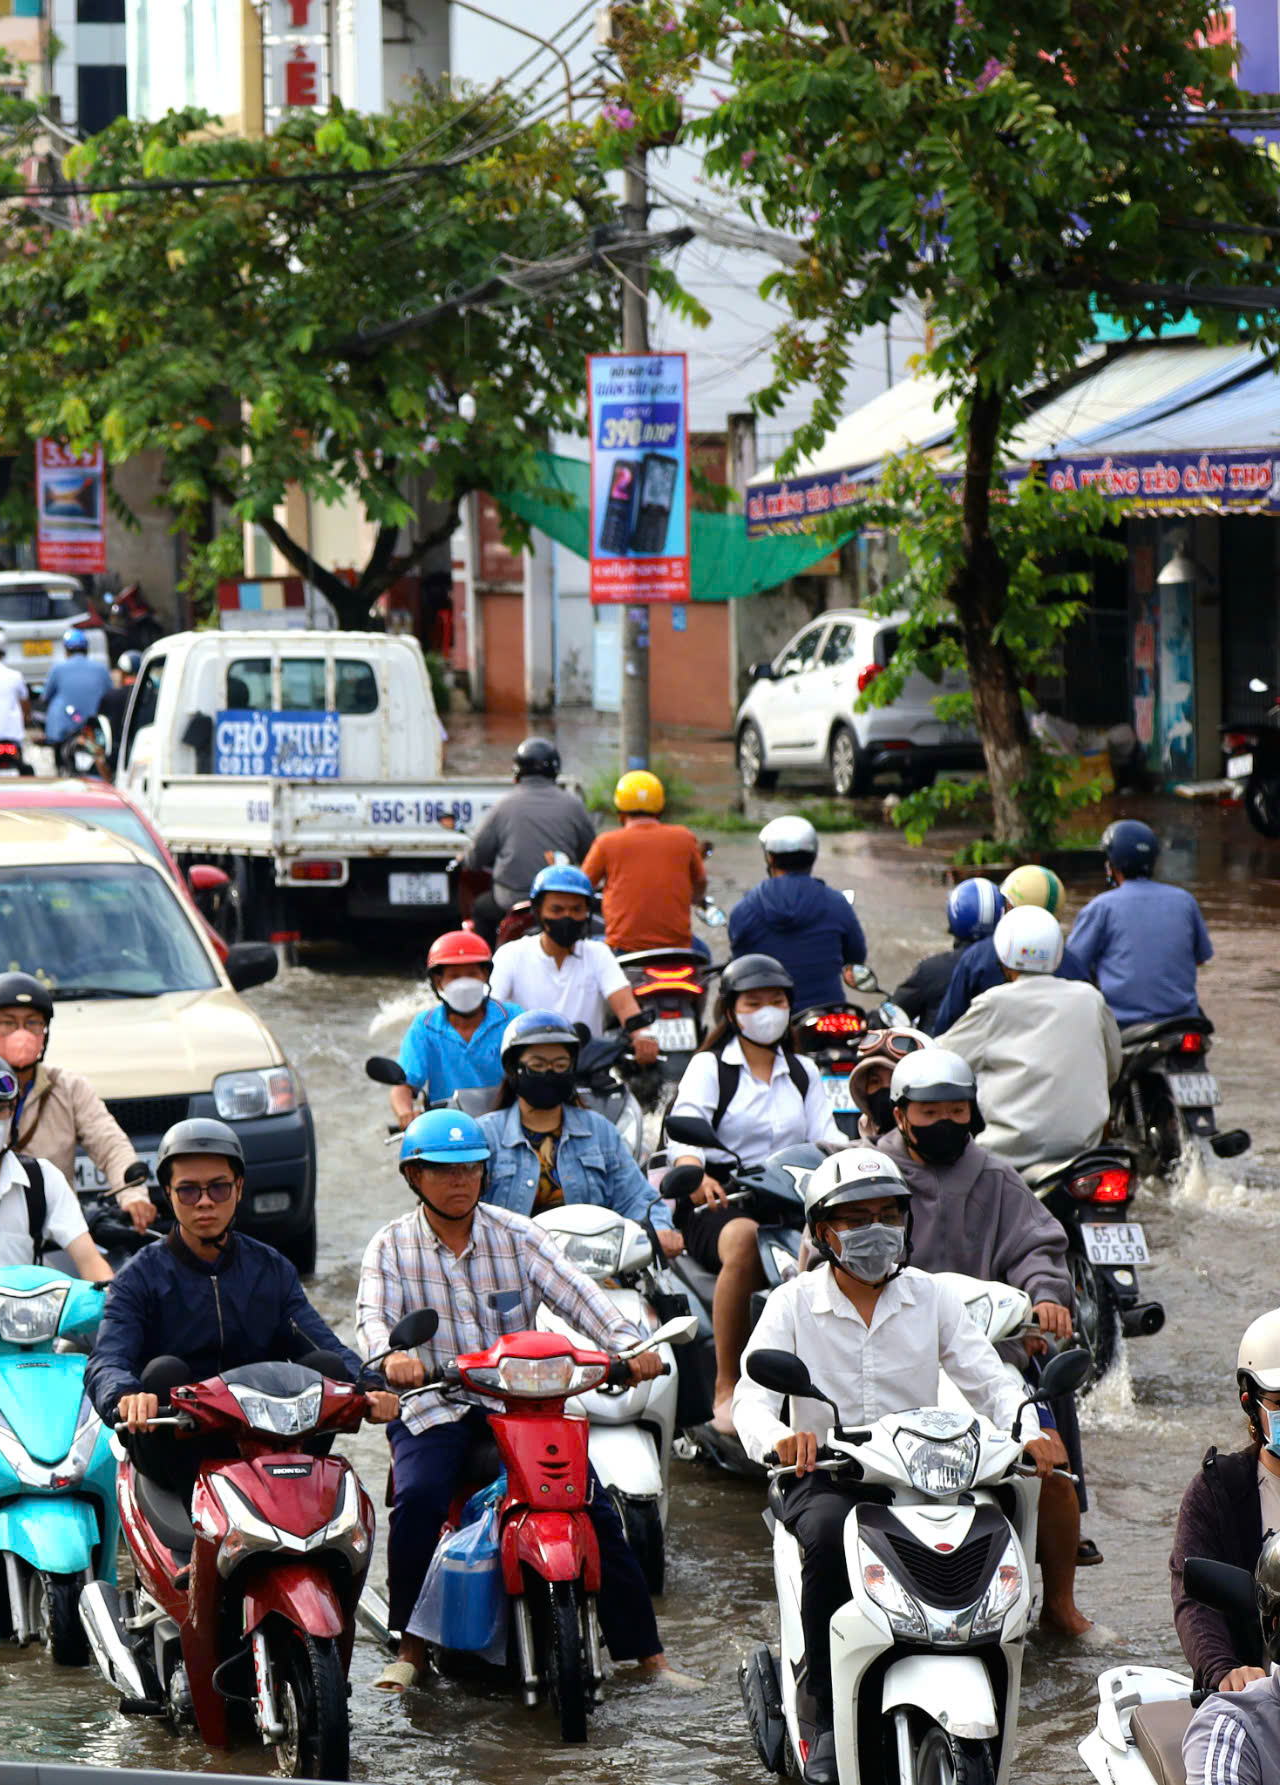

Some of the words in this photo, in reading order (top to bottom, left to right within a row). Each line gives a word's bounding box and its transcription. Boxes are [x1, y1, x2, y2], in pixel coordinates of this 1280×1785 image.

[271, 714, 339, 757] THUÊ
[371, 800, 473, 825] 65C-19689
[1093, 1226, 1135, 1244] 65-CA
[273, 1467, 308, 1475] HONDA
